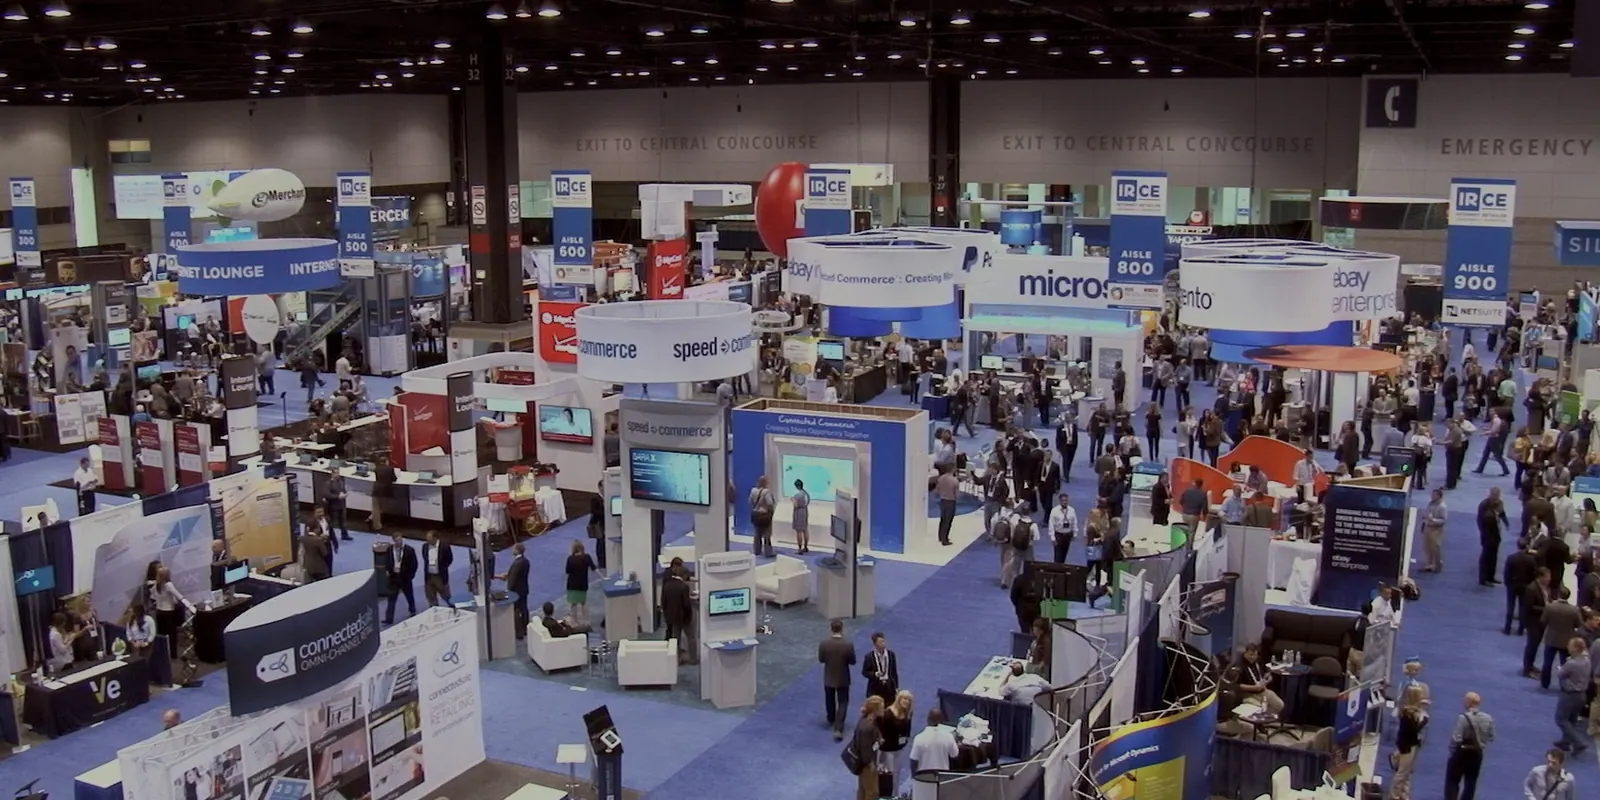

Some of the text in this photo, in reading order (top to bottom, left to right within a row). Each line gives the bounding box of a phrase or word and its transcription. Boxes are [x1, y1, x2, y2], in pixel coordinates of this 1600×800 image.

[469, 54, 478, 64] H
[468, 69, 480, 81] 32
[505, 69, 515, 80] 32
[575, 134, 818, 152] EXIT TO CENTRAL CONCOURSE
[1001, 135, 1315, 152] EXIT TO CENTRAL CONCOURSE
[1440, 138, 1593, 157] EMERGENCY
[340, 179, 366, 195] IRCE
[555, 177, 587, 195] IRCE
[809, 177, 846, 196] IRCE
[1116, 181, 1160, 200] IRCE
[1456, 188, 1508, 210] IRCE
[169, 238, 189, 249] 400
[345, 241, 368, 252] 500
[561, 236, 584, 244] AISLE
[559, 246, 586, 258] 600
[1120, 250, 1152, 259] AISLE
[202, 265, 265, 280] LOUNGE
[1117, 261, 1154, 275] 800
[1459, 263, 1495, 274] AISLE
[1454, 275, 1497, 291] 900
[1460, 307, 1503, 317] NETSUITE
[673, 336, 718, 362] speed
[627, 420, 713, 437] speed commerce
[764, 422, 790, 434] Creating
[843, 430, 870, 440] Together
[89, 676, 121, 704] Ve
